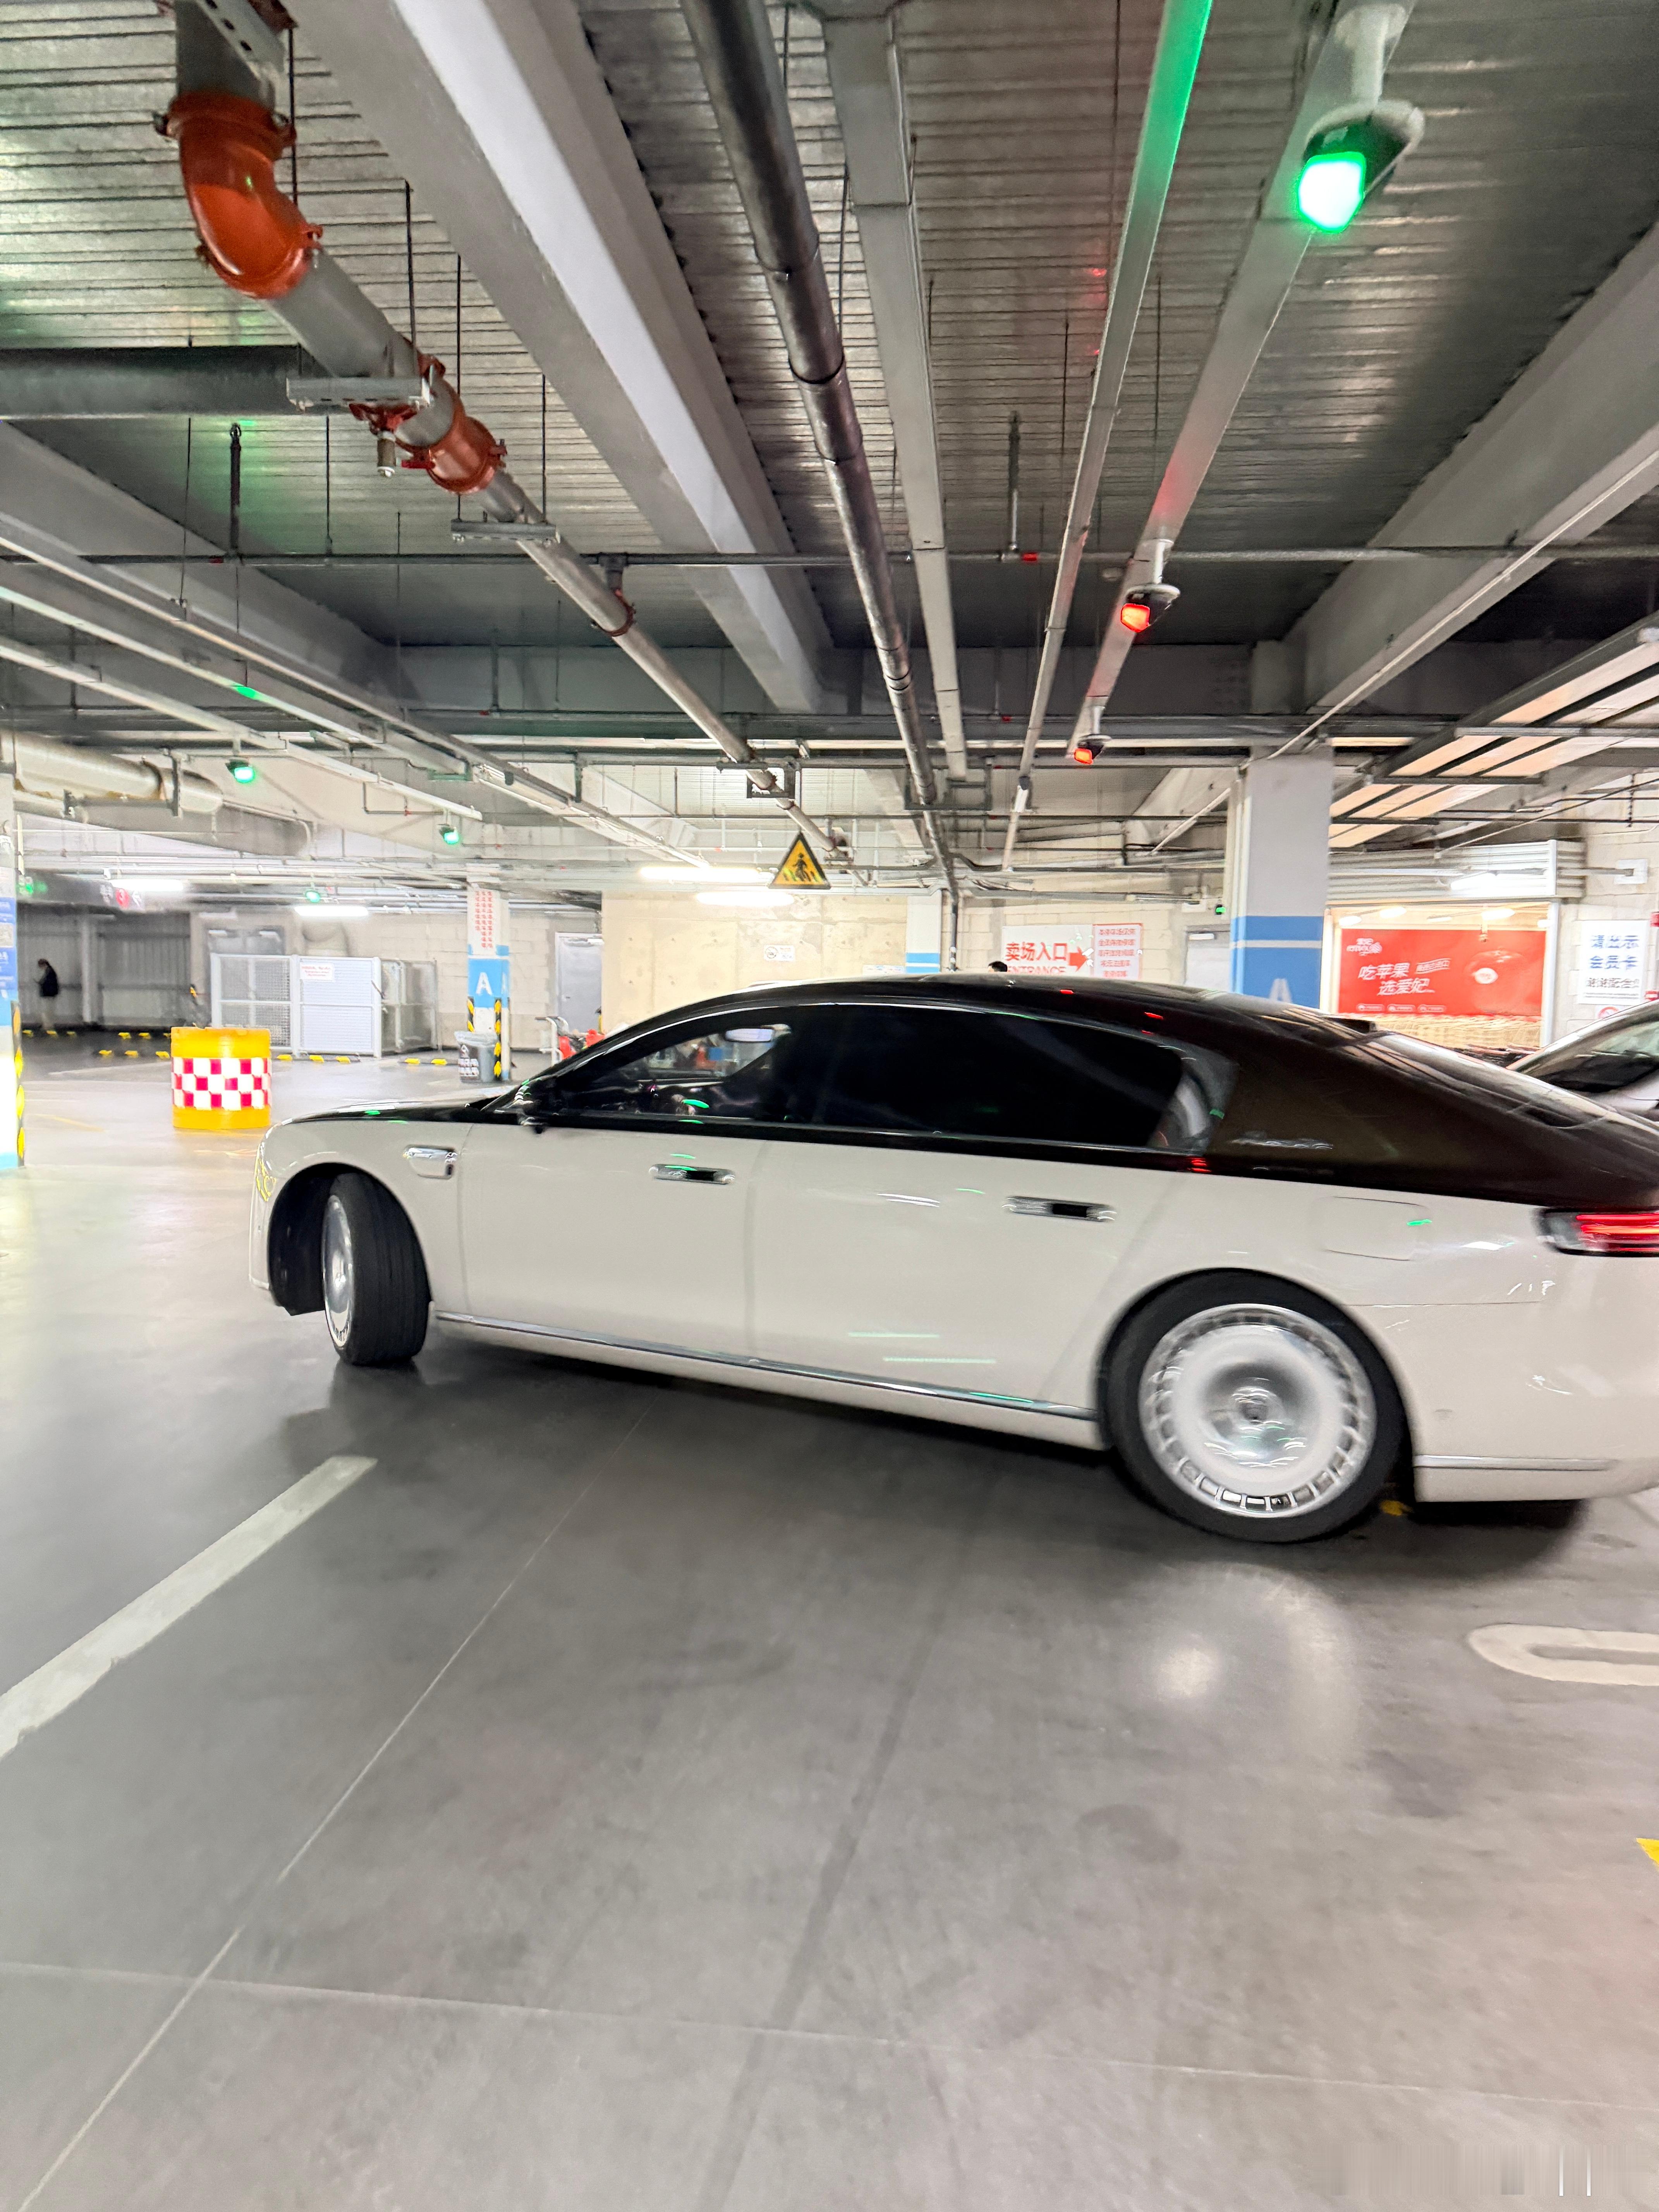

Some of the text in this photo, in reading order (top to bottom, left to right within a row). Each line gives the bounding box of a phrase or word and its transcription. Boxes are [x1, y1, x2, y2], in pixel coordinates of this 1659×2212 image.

[1005, 941, 1067, 961] 卖场入口
[1590, 935, 1640, 949] 请出示
[1358, 962, 1410, 981] 吃苹果
[1590, 955, 1639, 970] 会员卡
[475, 972, 493, 996] A
[1377, 977, 1435, 996] 选爱妃
